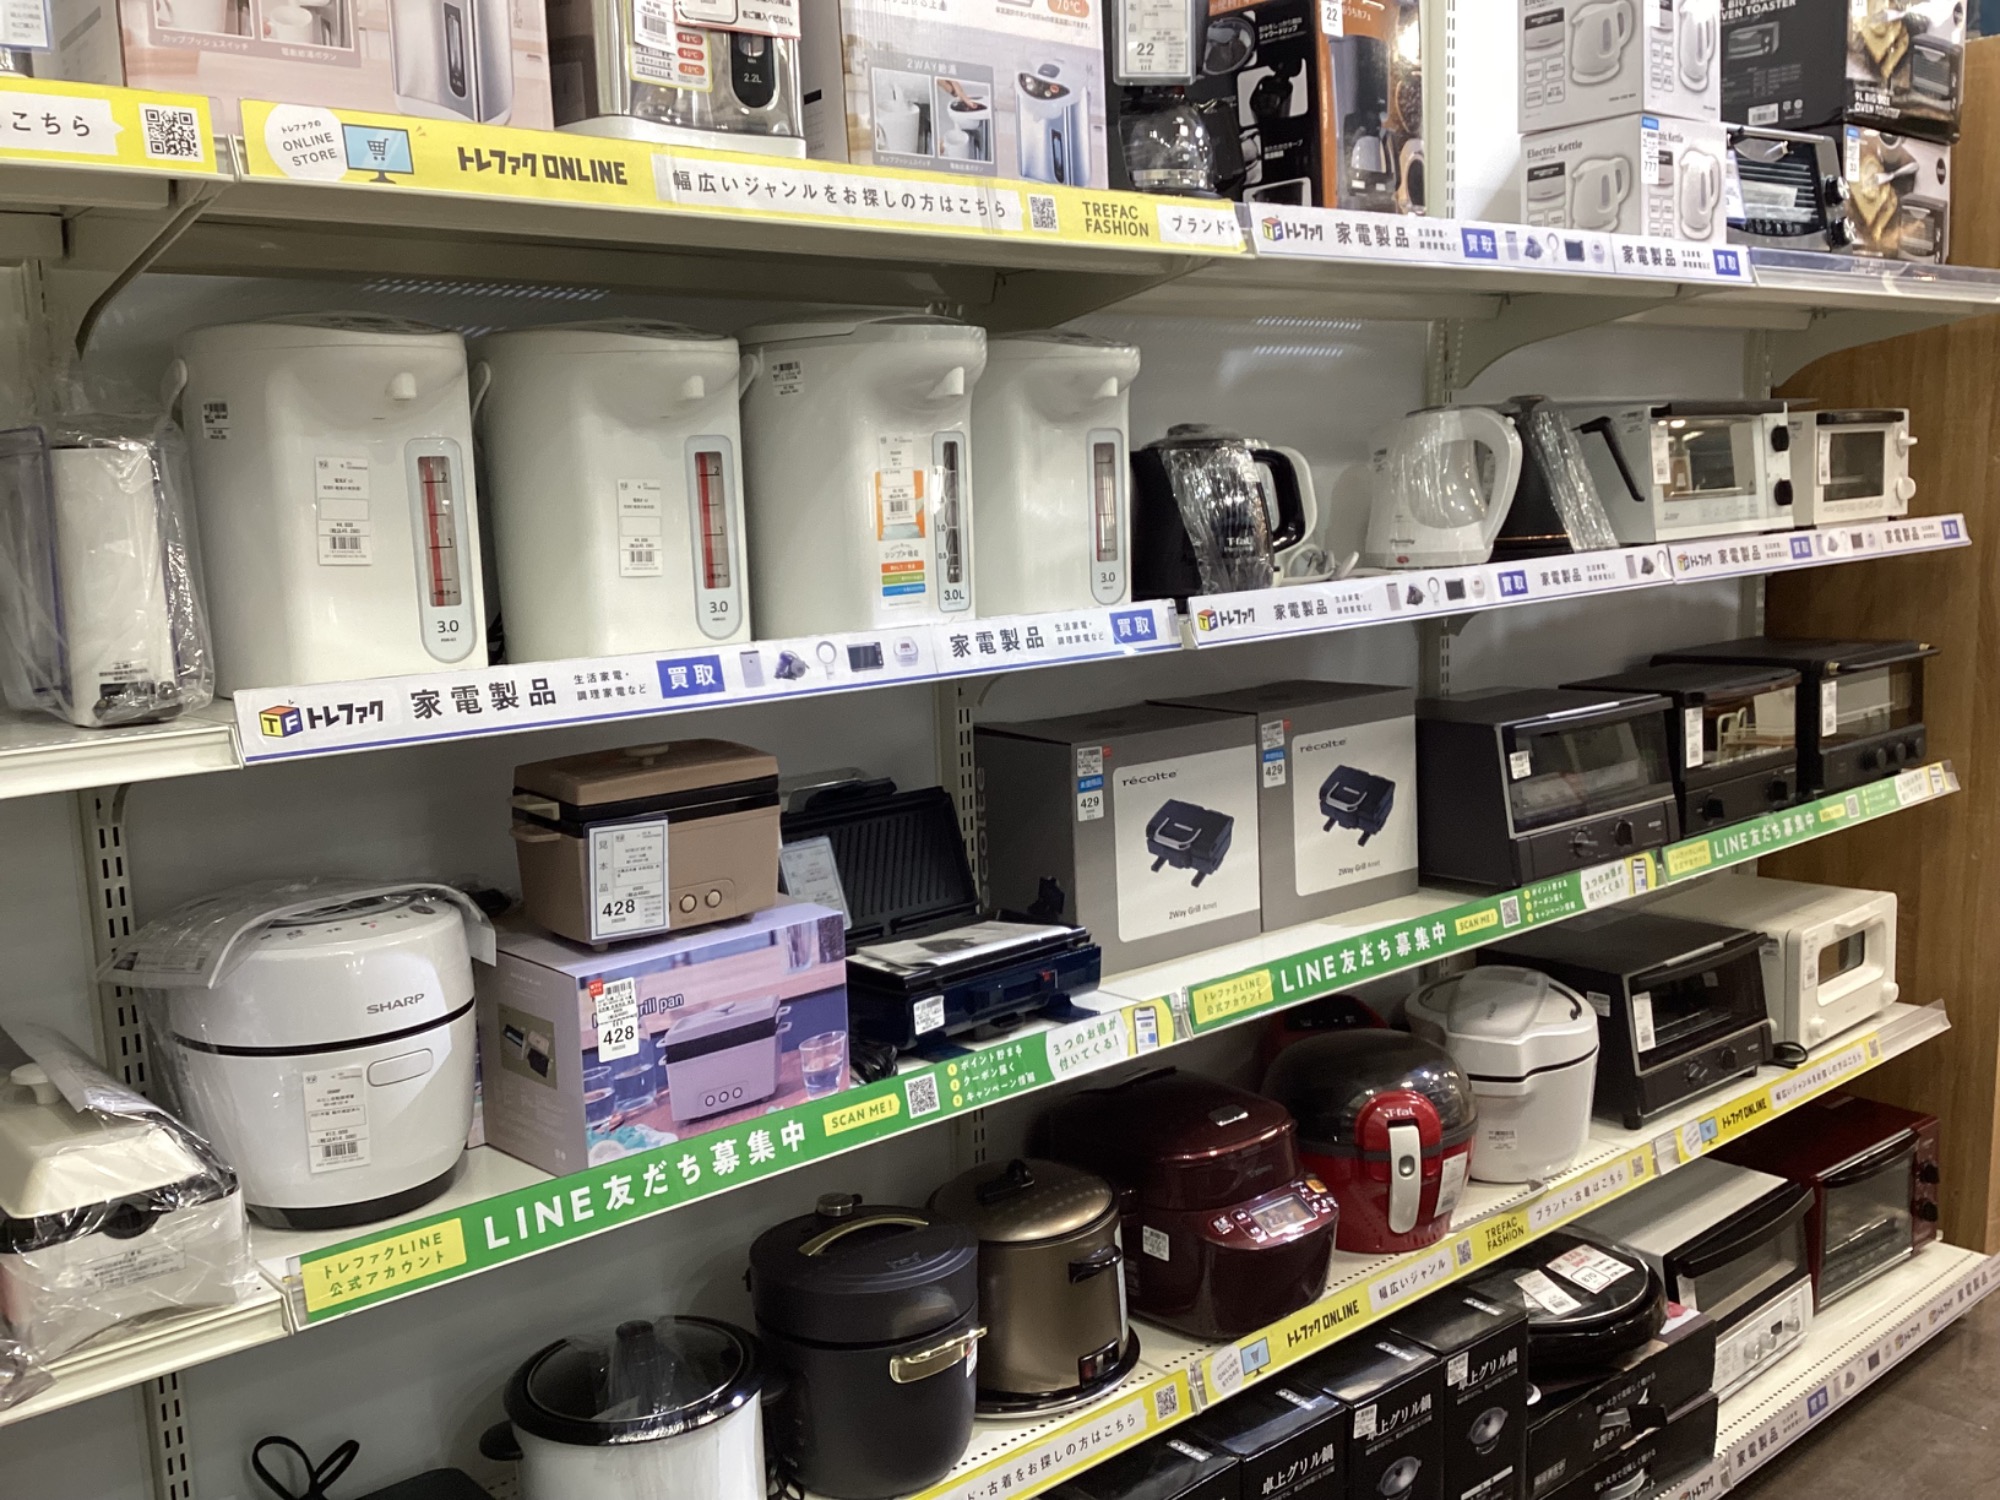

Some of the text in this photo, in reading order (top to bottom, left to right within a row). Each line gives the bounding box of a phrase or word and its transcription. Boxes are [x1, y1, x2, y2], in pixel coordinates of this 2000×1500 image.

[1326, 7, 1338, 21] 22
[1136, 42, 1155, 56] 22
[282, 132, 334, 153] ONLINE
[1558, 139, 1583, 154] Kettle
[292, 148, 338, 166] STORE
[542, 154, 628, 186] ONLINE
[672, 167, 1007, 218] 幅広いジャンルをお探しの方はこちら
[1082, 201, 1140, 220] TREFAC
[1085, 218, 1150, 237] FASHION
[1337, 222, 1409, 248] 家電製品
[1467, 233, 1494, 252] 買取
[1621, 245, 1676, 267] 家電製品
[1100, 572, 1116, 583] 3.0
[1502, 577, 1526, 593] 買取
[1540, 568, 1583, 587] 家電製品
[944, 590, 965, 601] 3.0L
[709, 601, 728, 613] 3.0
[1273, 599, 1328, 621] 家電製品
[436, 620, 459, 633] 3.0
[1117, 617, 1151, 637] 買取
[949, 626, 1045, 658] 家電製品
[668, 664, 716, 690] 買取
[410, 678, 557, 720] 家電製品
[576, 683, 647, 701] 調理家電など
[306, 700, 384, 729] トレファク
[1300, 737, 1347, 754] récolte
[1121, 769, 1178, 787] récolte
[1265, 764, 1283, 777] 429
[1080, 796, 1100, 809] 429
[602, 899, 635, 917] 428
[1459, 917, 1480, 931] SCAN
[366, 992, 425, 1015] SHARP
[660, 993, 685, 1015] pan
[603, 1025, 635, 1045] 428
[831, 1110, 866, 1129] SCAN
[1485, 1216, 1518, 1240] TREFAC
[1487, 1224, 1525, 1252] FASHION
[330, 1251, 445, 1299] 公式アカウント
[1378, 1259, 1446, 1300] 幅広いジャンル
[1322, 1299, 1360, 1330] ONLINE
[1736, 1426, 1779, 1468] 家電製品
[1261, 1443, 1335, 1496] 卓上グリル鍋
